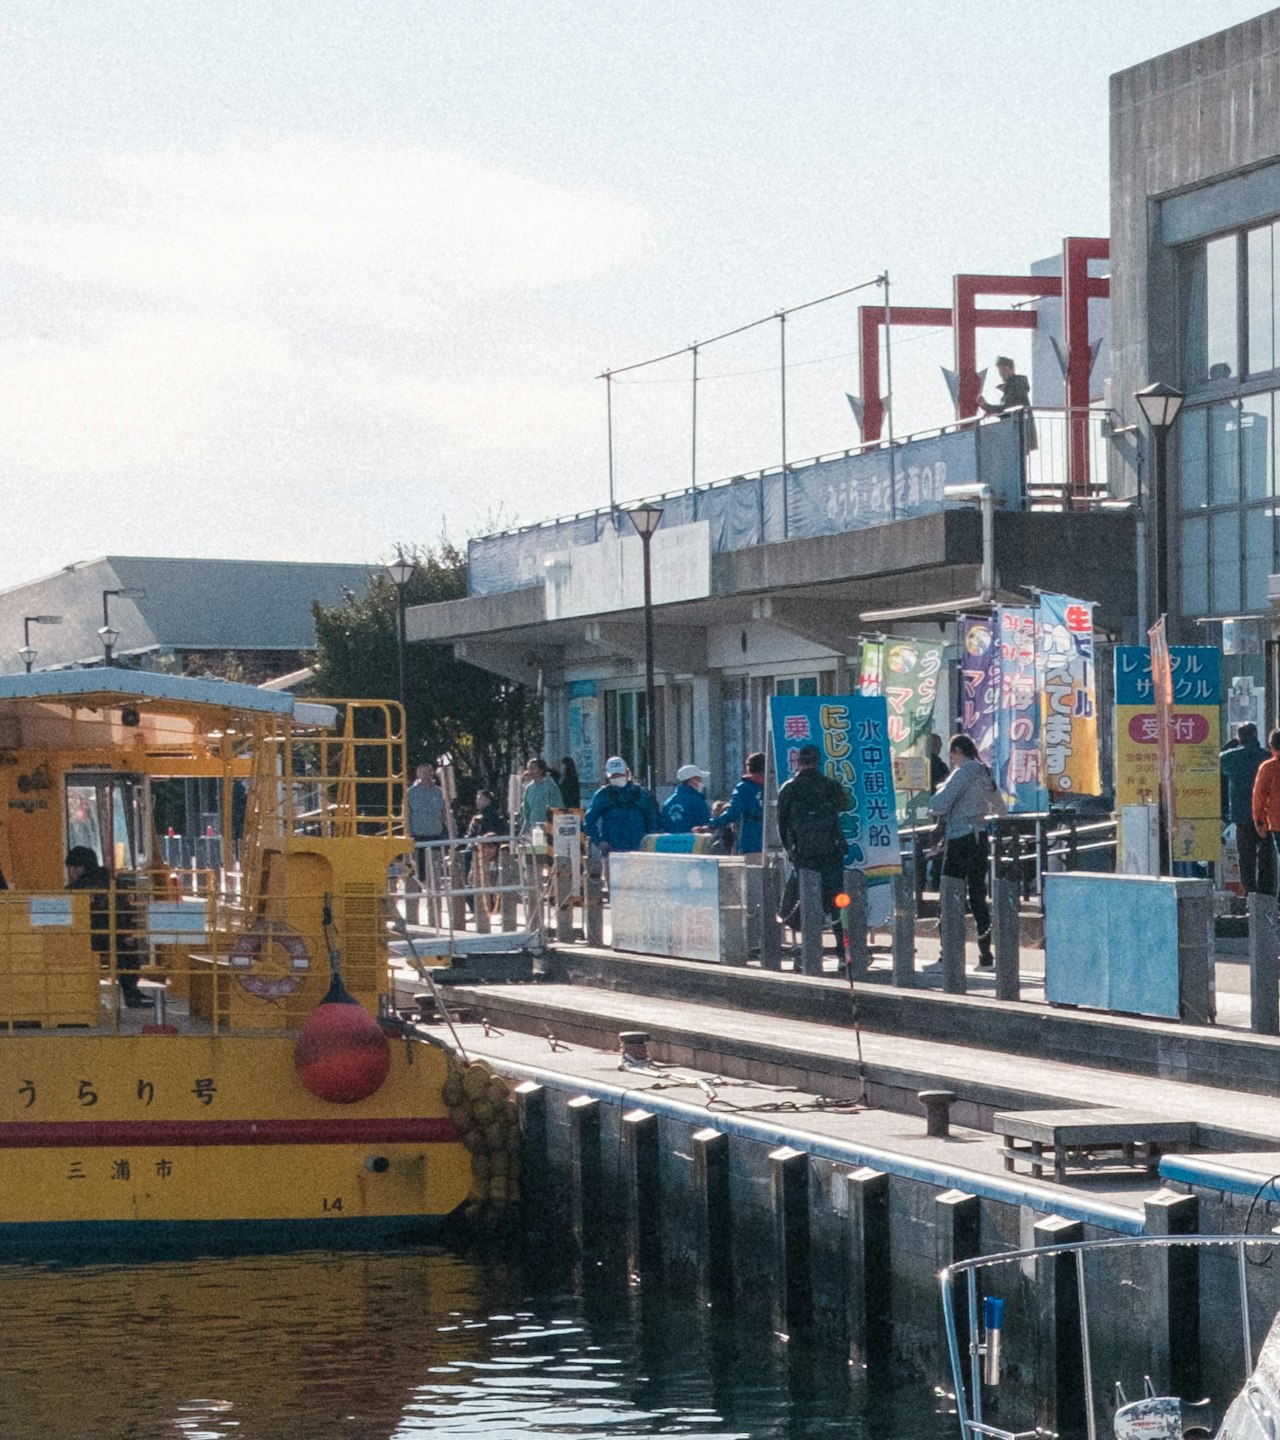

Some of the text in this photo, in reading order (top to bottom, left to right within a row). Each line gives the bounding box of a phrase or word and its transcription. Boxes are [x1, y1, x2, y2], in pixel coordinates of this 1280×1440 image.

[1065, 605, 1094, 718] 生ビール
[1136, 678, 1213, 699] サクル
[1042, 622, 1073, 790] 冷えてます。
[858, 719, 891, 847] 水中観光船
[18, 1079, 218, 1107] うらり号
[66, 1160, 173, 1181] 三浦市
